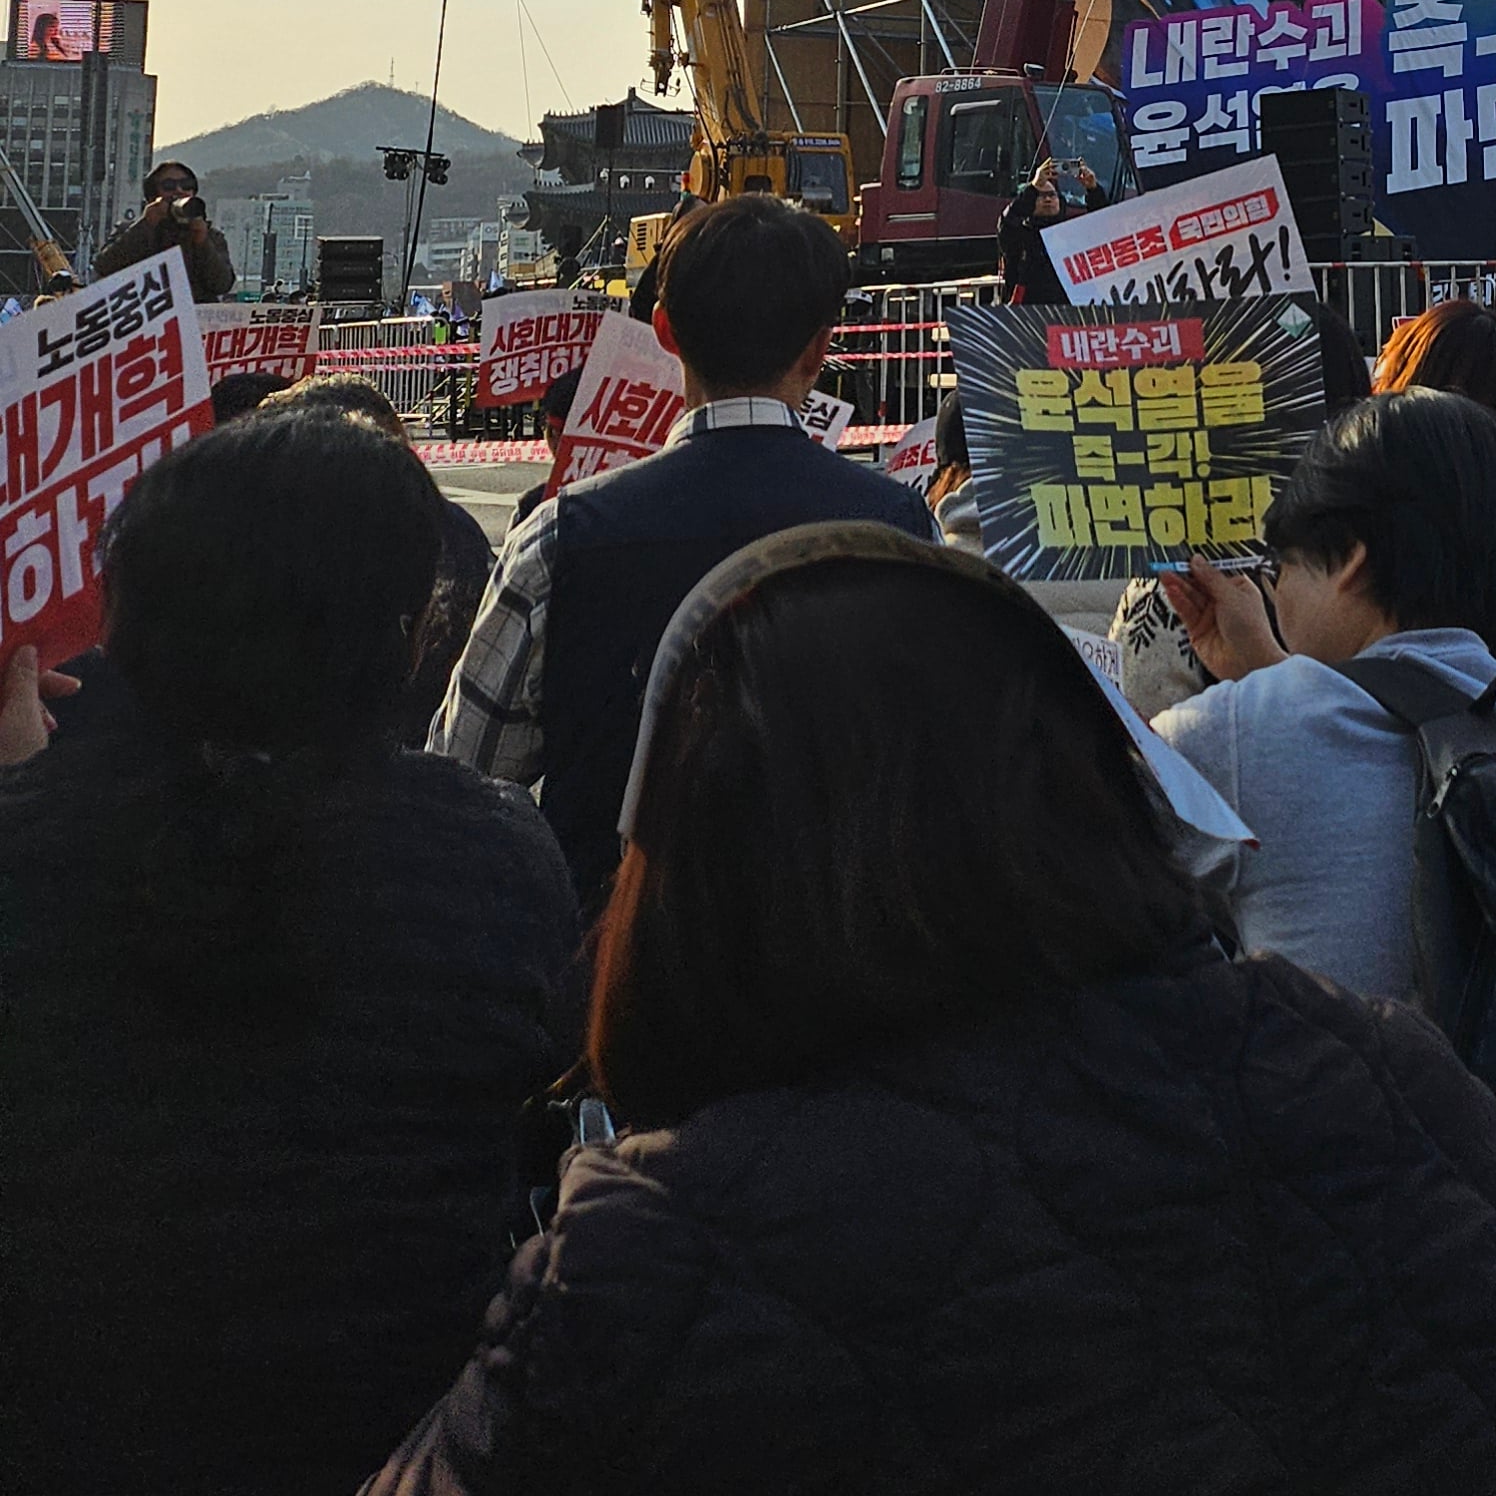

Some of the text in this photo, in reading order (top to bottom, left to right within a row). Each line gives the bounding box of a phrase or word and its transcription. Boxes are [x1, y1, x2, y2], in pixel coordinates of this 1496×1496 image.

[935, 77, 981, 93] 82-8864
[1130, 73, 1361, 169] 윤석
[1063, 194, 1272, 286] 내란동조 국민의힘
[38, 262, 174, 378] 노동중심
[249, 308, 314, 325] 노동중심
[489, 311, 604, 356] 사회대개
[1060, 322, 1181, 364] 내란수괴
[577, 375, 686, 446] 사회
[1015, 360, 1265, 432] 윤석열을
